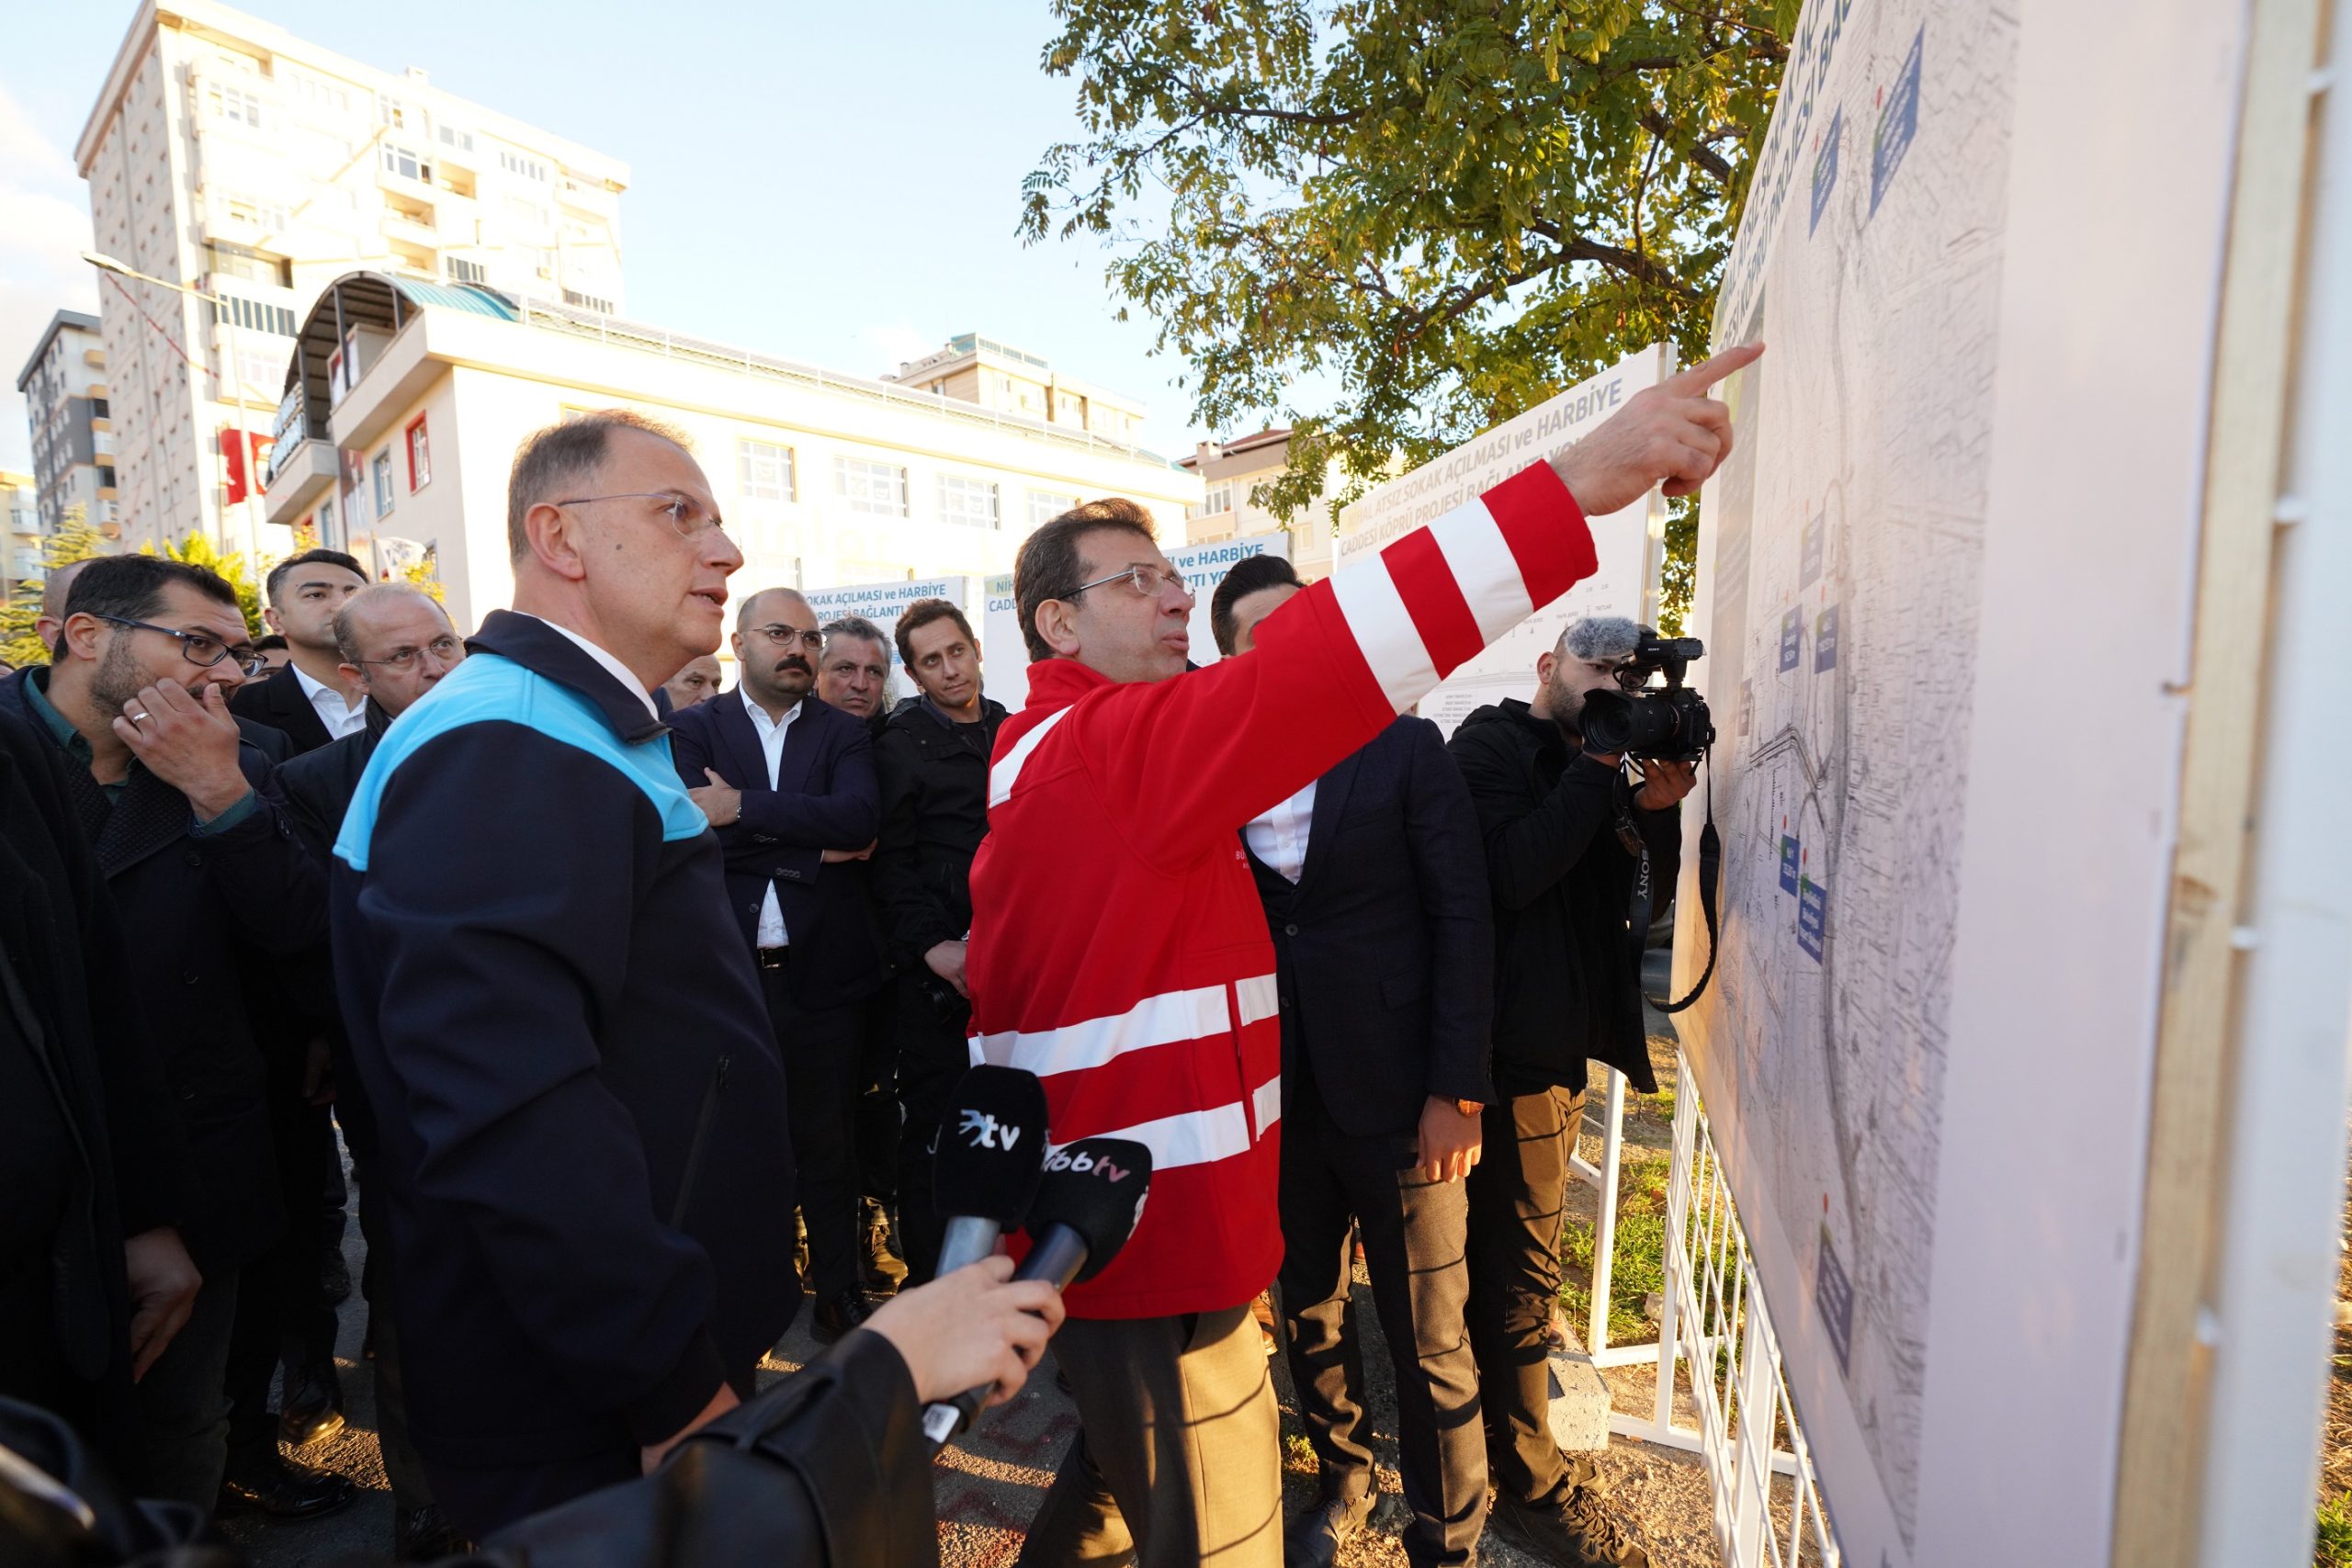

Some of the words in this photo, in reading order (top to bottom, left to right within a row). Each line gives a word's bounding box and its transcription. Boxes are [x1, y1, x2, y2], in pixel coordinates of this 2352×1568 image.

[1374, 487, 1403, 515] ATSIZ
[1403, 468, 1442, 502] SOKAK
[1444, 433, 1511, 483] AÇILMASI
[1514, 428, 1532, 450] ve
[1536, 378, 1623, 440] HARBİYE
[1341, 522, 1377, 557] CADDESİ
[1379, 506, 1413, 541] KÖPRÜ
[1414, 483, 1464, 525] PROJESİ
[1179, 556, 1194, 568] ve
[1198, 542, 1264, 566] HARBİYE
[808, 593, 832, 606] OKAK
[835, 590, 882, 609] AÇILMASI
[885, 591, 897, 601] ve
[899, 581, 946, 599] HARBİYE
[1637, 849, 1650, 901] SONY
